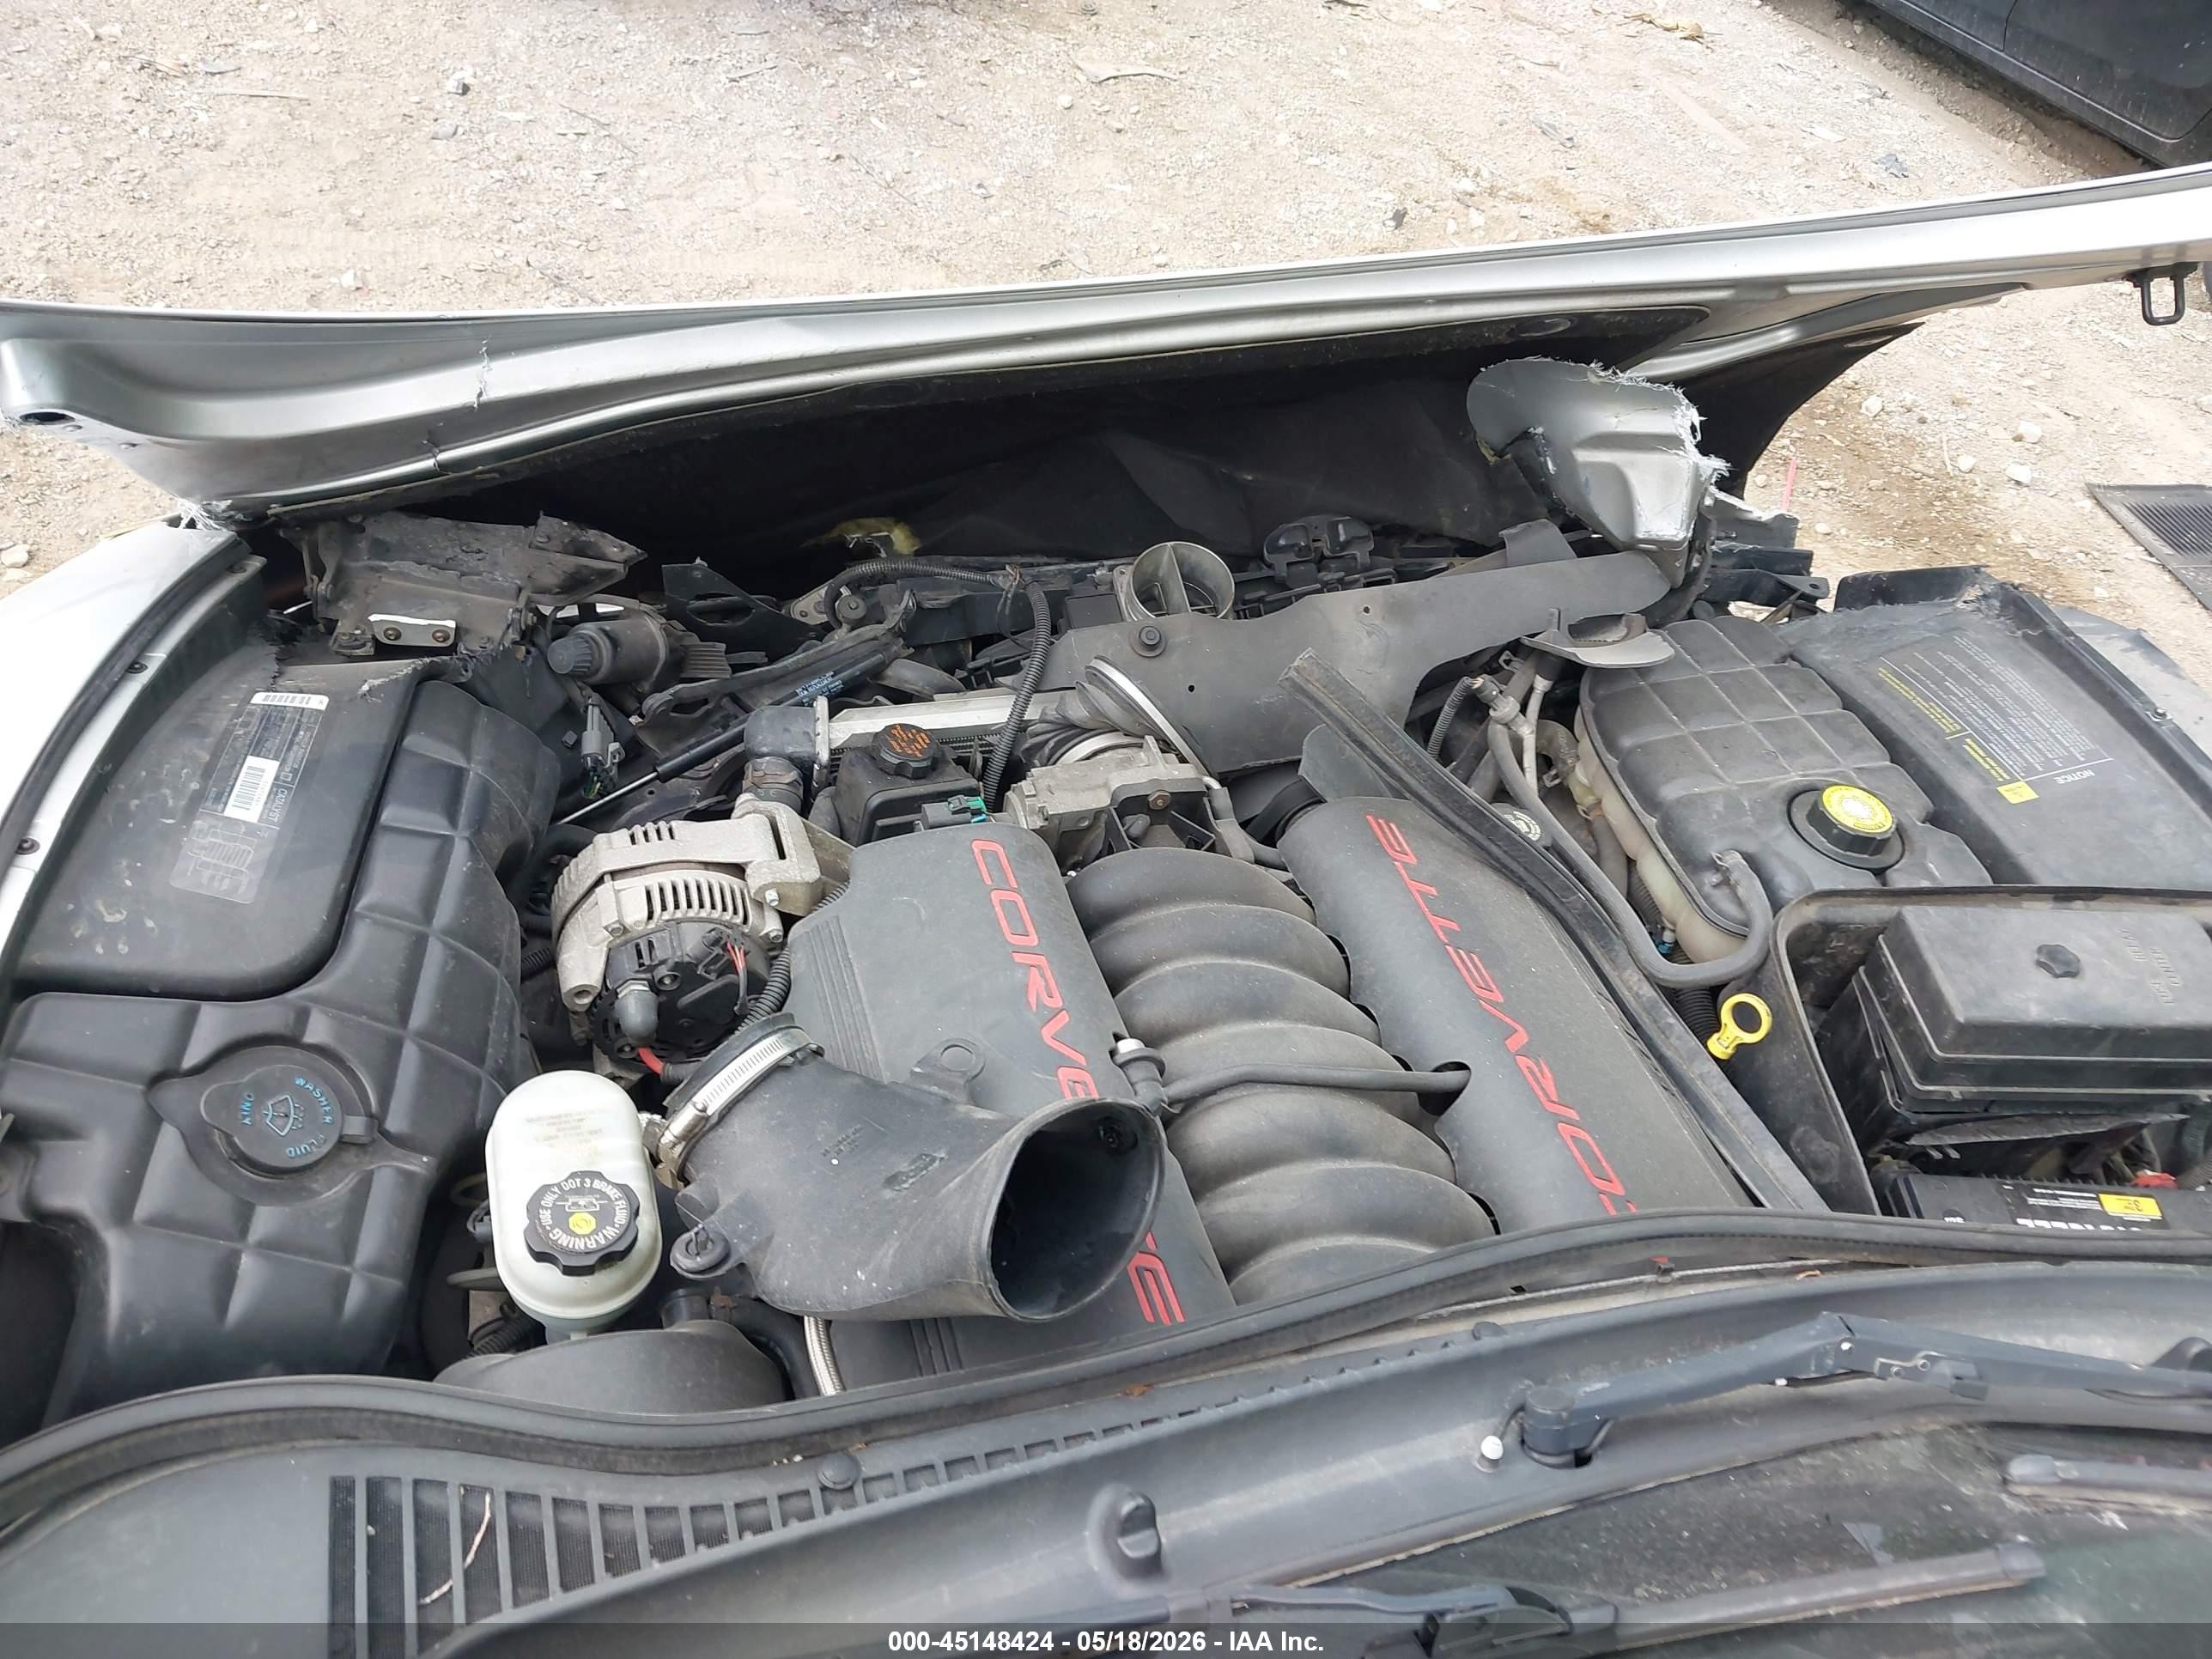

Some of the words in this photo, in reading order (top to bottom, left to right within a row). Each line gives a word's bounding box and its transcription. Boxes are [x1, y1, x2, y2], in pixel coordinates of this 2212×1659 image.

[2053, 769, 2096, 783] NOTICE
[267, 787, 288, 823] CATALYST
[240, 1092, 255, 1125] ONLY
[295, 1077, 334, 1125] WASHER
[287, 1133, 326, 1158] FLUID
[562, 1177, 582, 1191] DOT
[584, 1177, 592, 1188] 3
[592, 1179, 623, 1201] BRAKE
[541, 1187, 562, 1207] ONLY
[538, 1208, 552, 1226] USE
[613, 1200, 629, 1224] FLUID
[548, 1225, 620, 1251] WARNING
